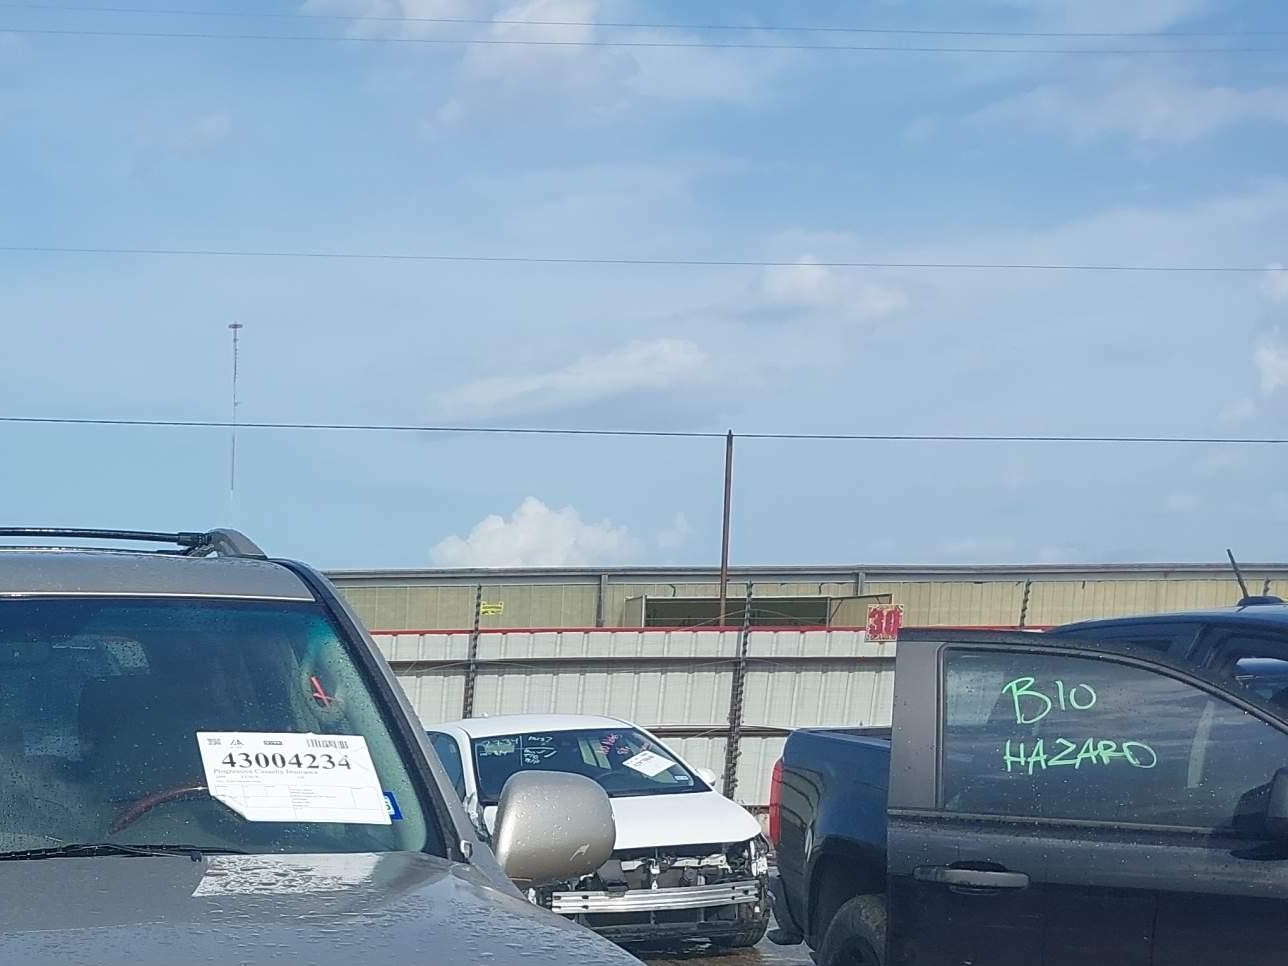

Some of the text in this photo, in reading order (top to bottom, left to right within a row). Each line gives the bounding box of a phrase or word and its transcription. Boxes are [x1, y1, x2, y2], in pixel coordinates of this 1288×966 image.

[868, 609, 900, 635] 30
[1002, 677, 1097, 724] BIO
[221, 751, 352, 770] 43004234
[1003, 737, 1157, 775] HAZARD
